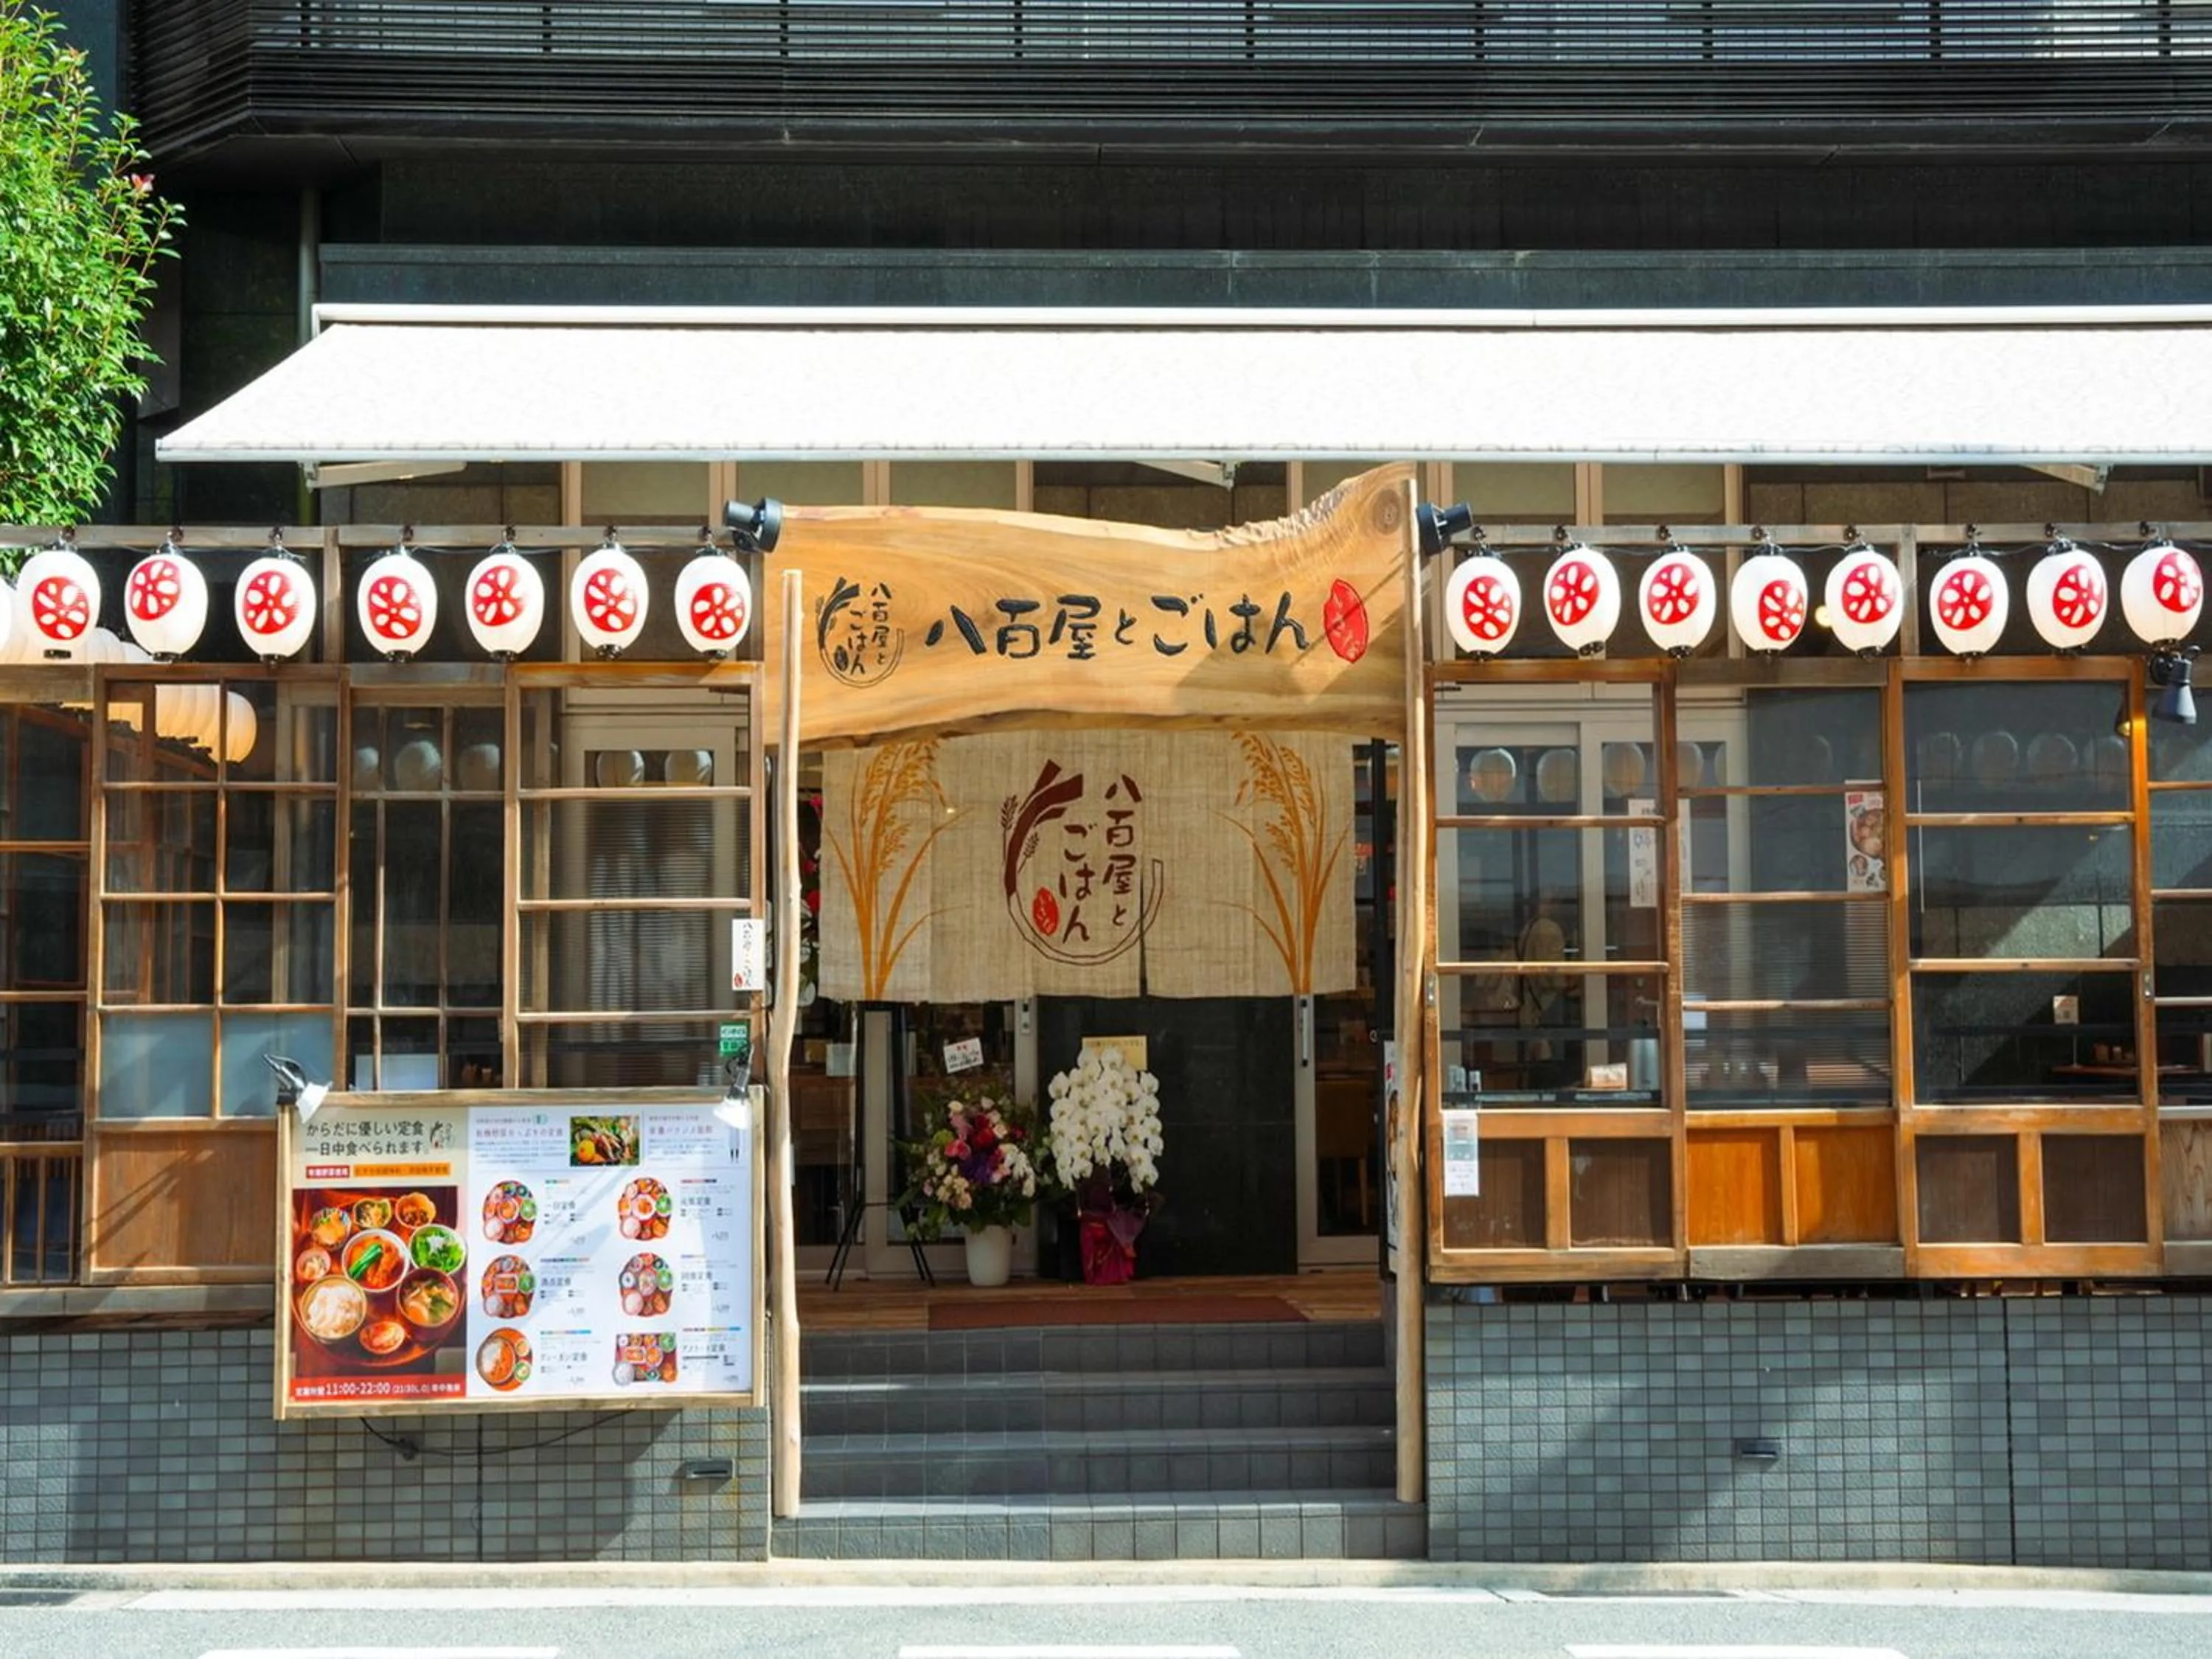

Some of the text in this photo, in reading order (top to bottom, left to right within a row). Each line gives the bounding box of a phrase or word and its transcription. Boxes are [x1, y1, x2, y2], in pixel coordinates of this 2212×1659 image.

[847, 609, 868, 675] ごはん
[871, 582, 891, 666] 八百屋と
[925, 590, 1310, 661] 八百屋とごはん
[1059, 822, 1097, 944] ごはん
[1102, 773, 1143, 928] 八百屋と
[306, 1120, 425, 1137] からだに優しい定食
[326, 1382, 392, 1395] 11:00-22:00
